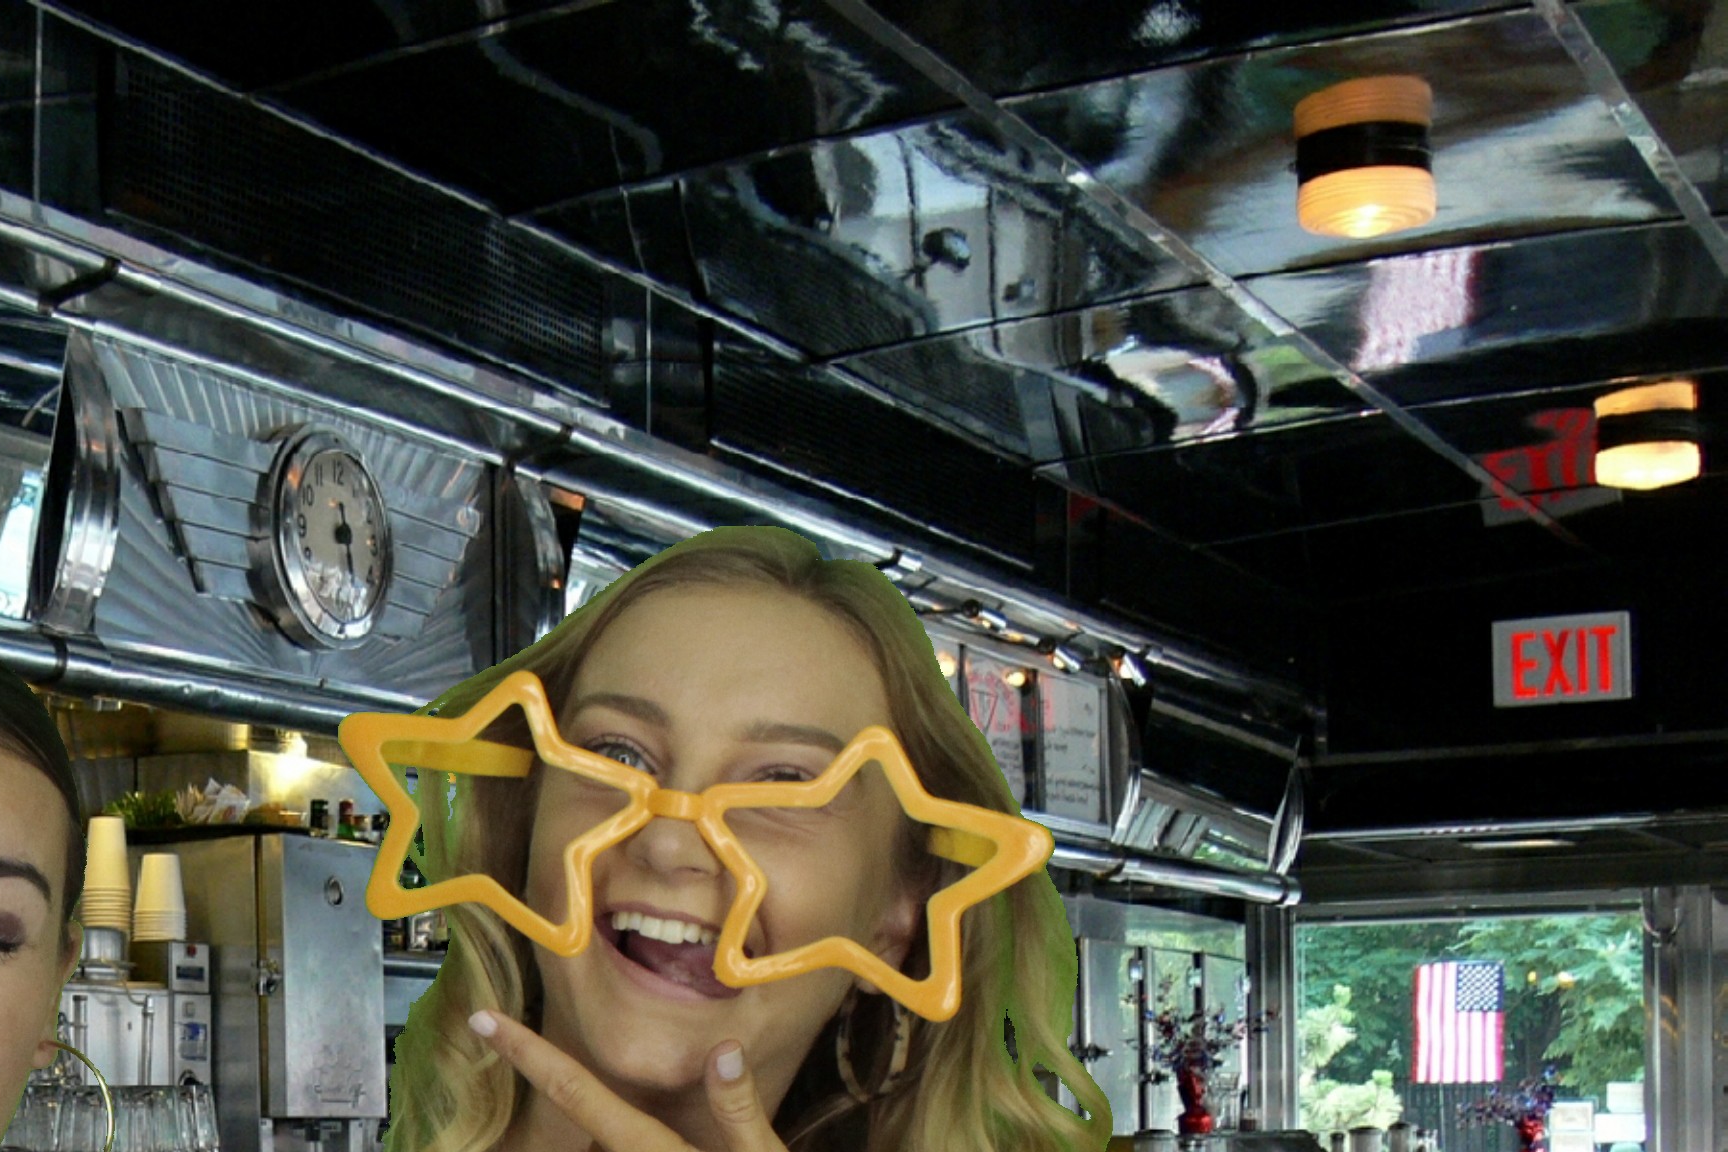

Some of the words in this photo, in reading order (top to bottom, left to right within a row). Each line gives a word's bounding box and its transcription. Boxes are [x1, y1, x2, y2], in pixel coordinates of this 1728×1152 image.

[314, 462, 323, 487] 11
[333, 459, 345, 486] 12
[302, 484, 315, 507] 10
[297, 513, 307, 538] 9
[1510, 625, 1618, 699] EXIT
